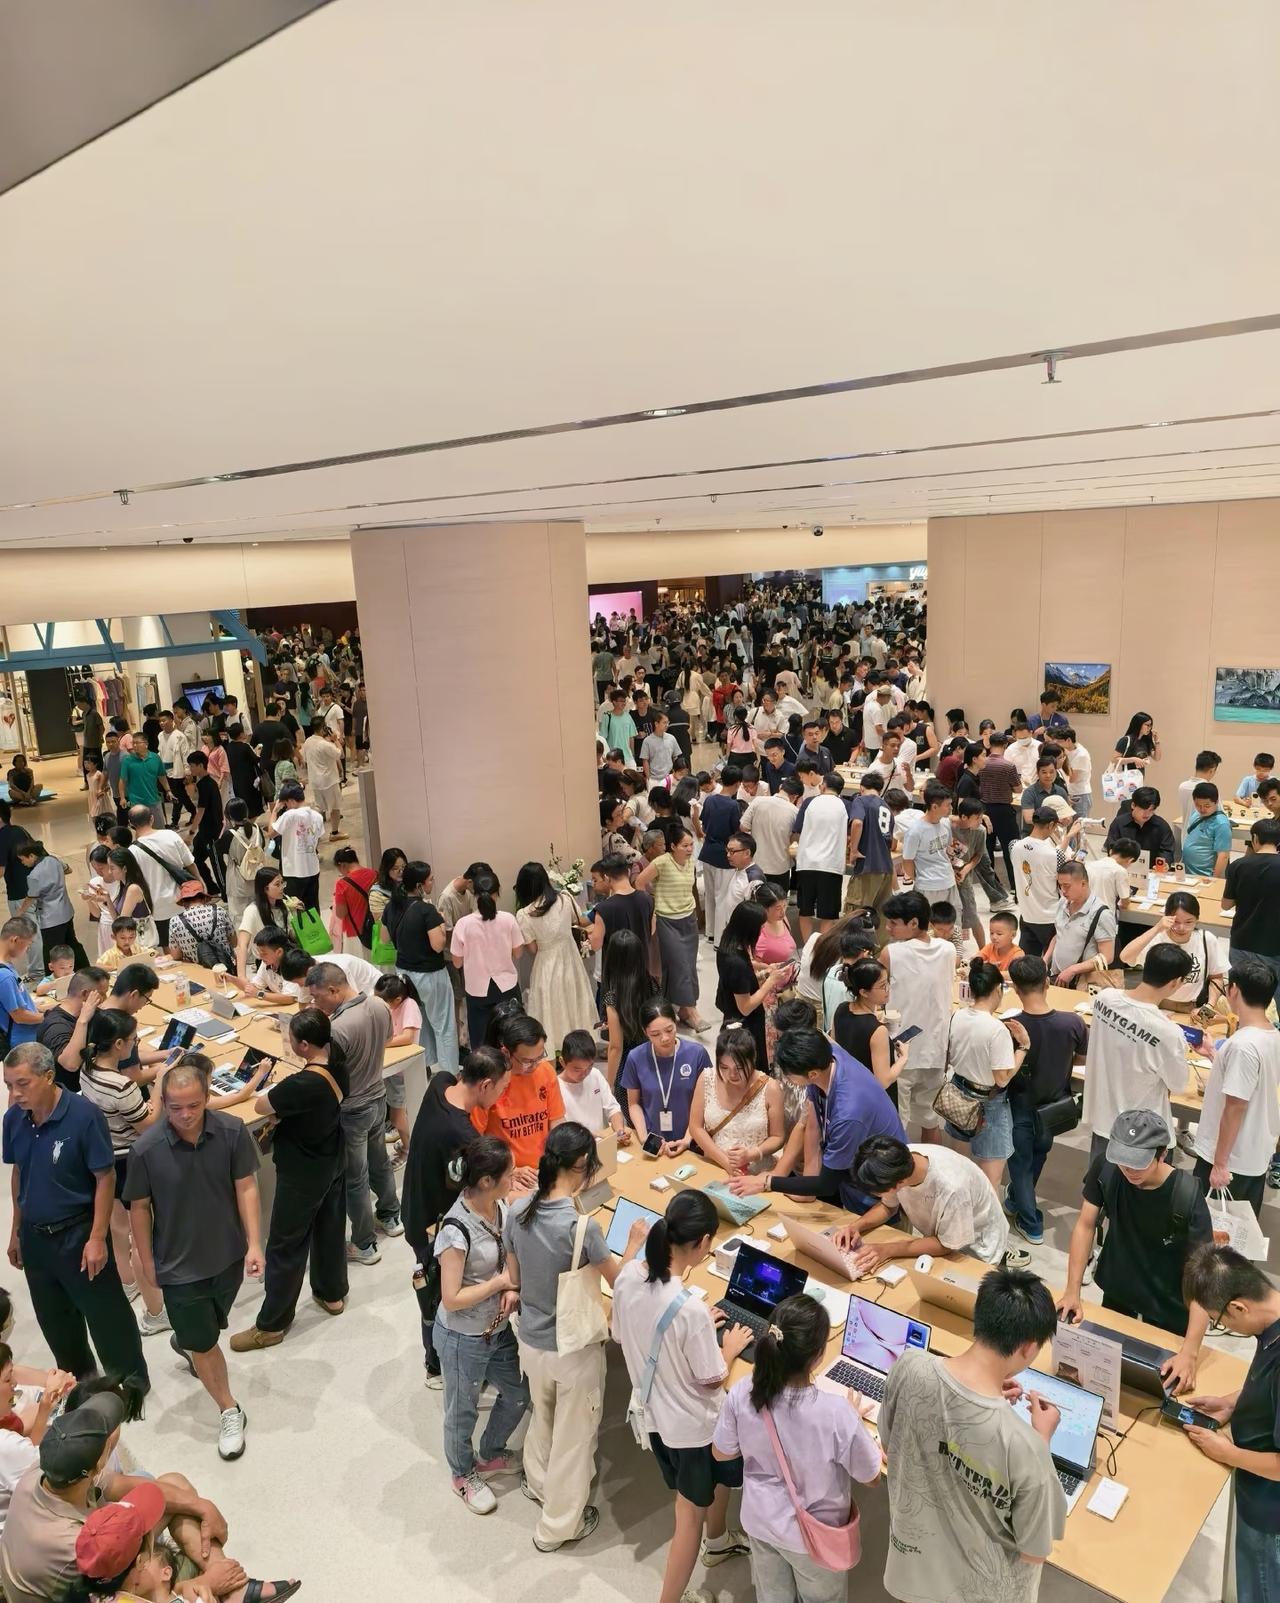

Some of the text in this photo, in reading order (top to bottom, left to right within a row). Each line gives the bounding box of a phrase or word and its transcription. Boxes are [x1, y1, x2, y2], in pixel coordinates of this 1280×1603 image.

[879, 805, 891, 834] 8
[501, 1109, 549, 1130] Emirates
[523, 1122, 544, 1136] BETTER
